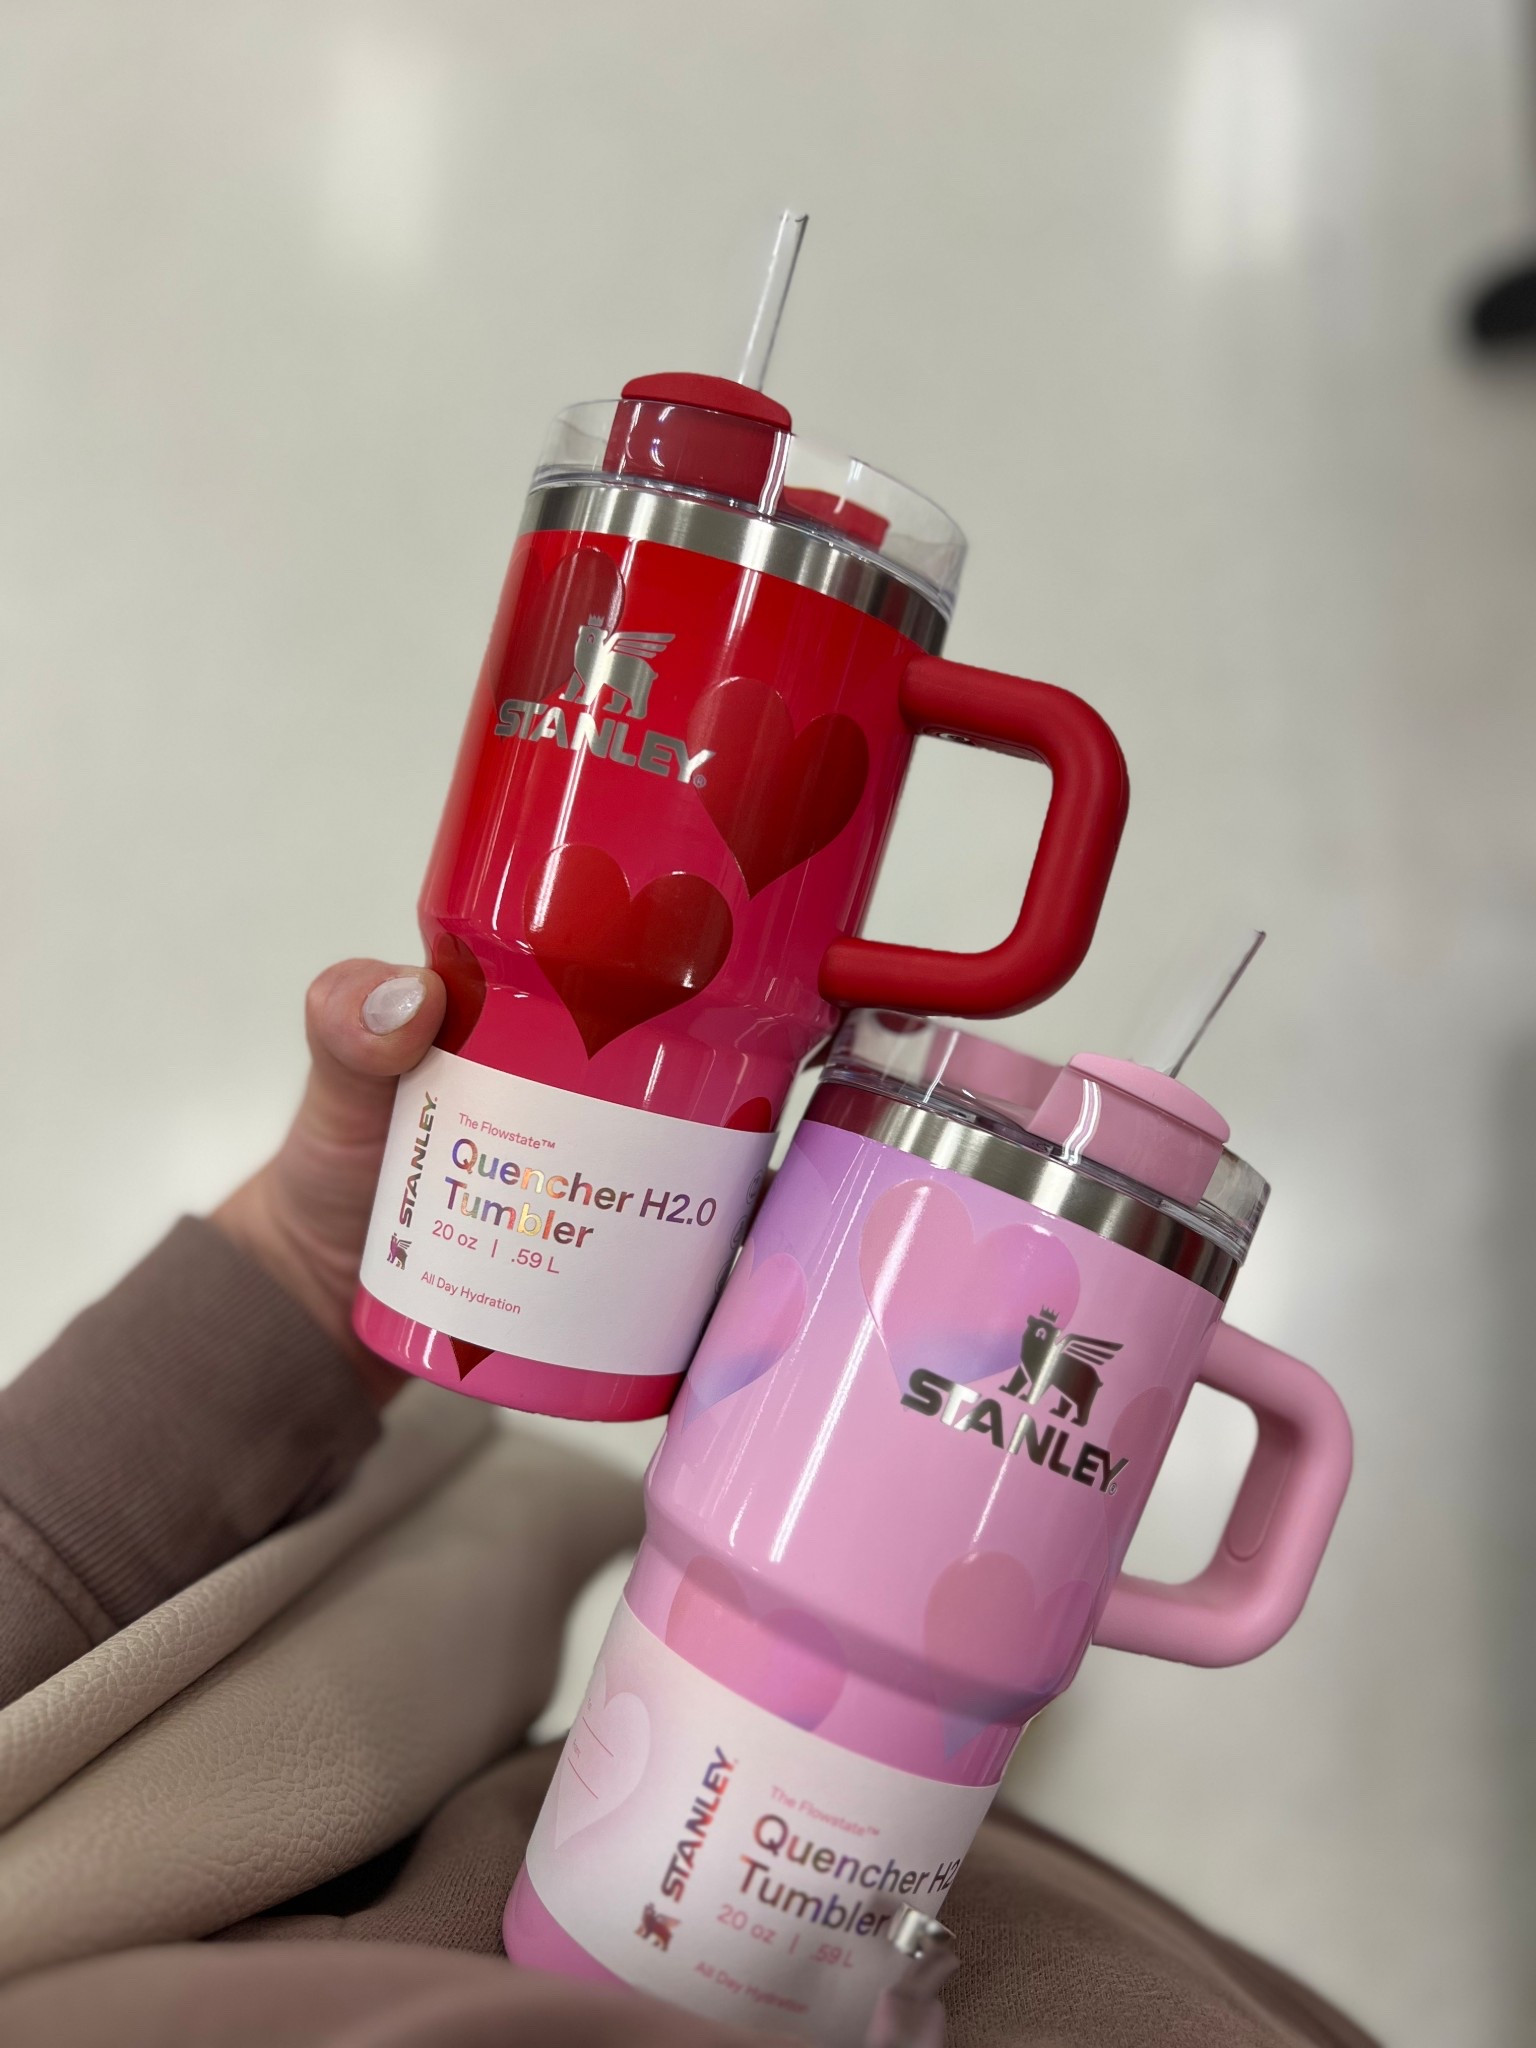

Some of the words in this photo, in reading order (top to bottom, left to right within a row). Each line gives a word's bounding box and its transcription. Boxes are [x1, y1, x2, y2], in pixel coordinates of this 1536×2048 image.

[459, 1112, 479, 1130] The
[452, 1138, 635, 1214] Quencher
[639, 1188, 717, 1227] H2.0
[445, 1176, 595, 1248] Tumbler
[432, 1219, 454, 1240] 20
[457, 1233, 478, 1250] oz
[511, 1248, 542, 1268] .59
[547, 1256, 560, 1274] L
[421, 1271, 435, 1285] All
[437, 1277, 459, 1295] Day
[460, 1286, 521, 1314] Hydration
[771, 1786, 796, 1808] The
[753, 1814, 931, 1895] Quencher
[740, 1854, 891, 1937] Tumbler
[717, 1903, 748, 1931] 20
[751, 1923, 776, 1944] oz
